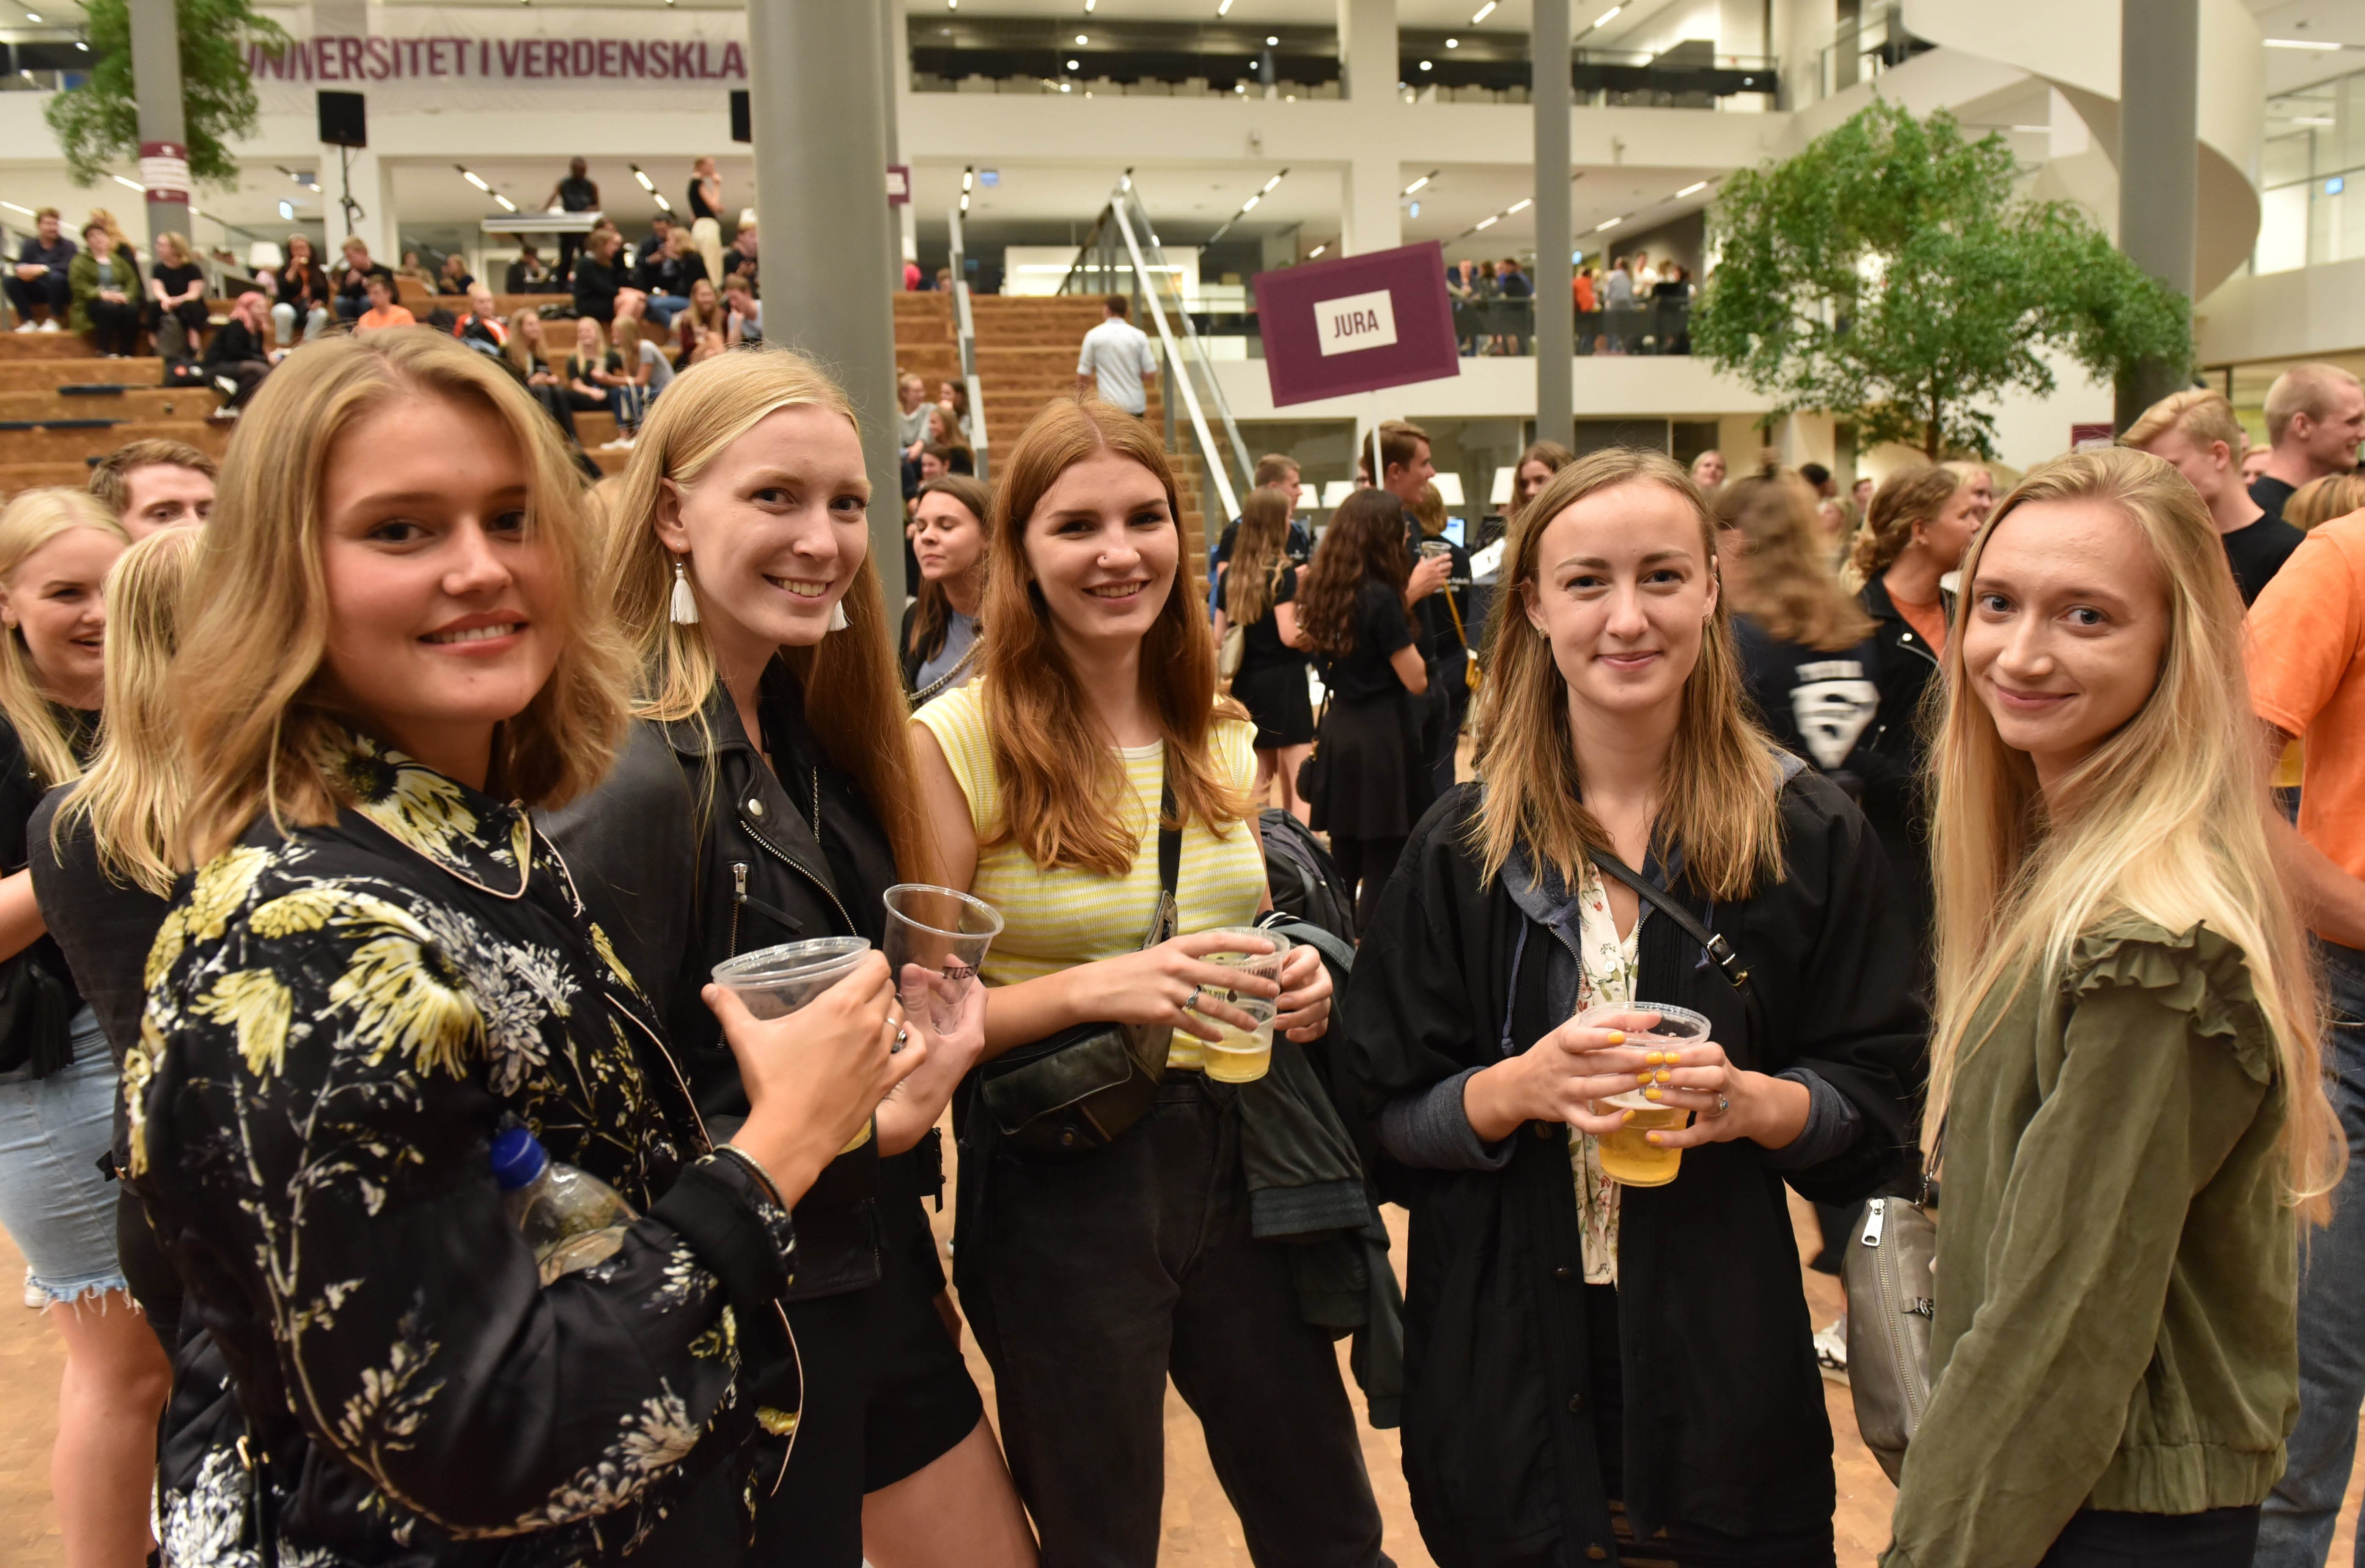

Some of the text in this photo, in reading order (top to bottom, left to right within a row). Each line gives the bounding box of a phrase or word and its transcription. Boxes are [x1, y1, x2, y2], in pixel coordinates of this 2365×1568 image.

[481, 38, 489, 75] I
[497, 38, 747, 79] VERDENSKLA
[1334, 310, 1379, 338] JURA
